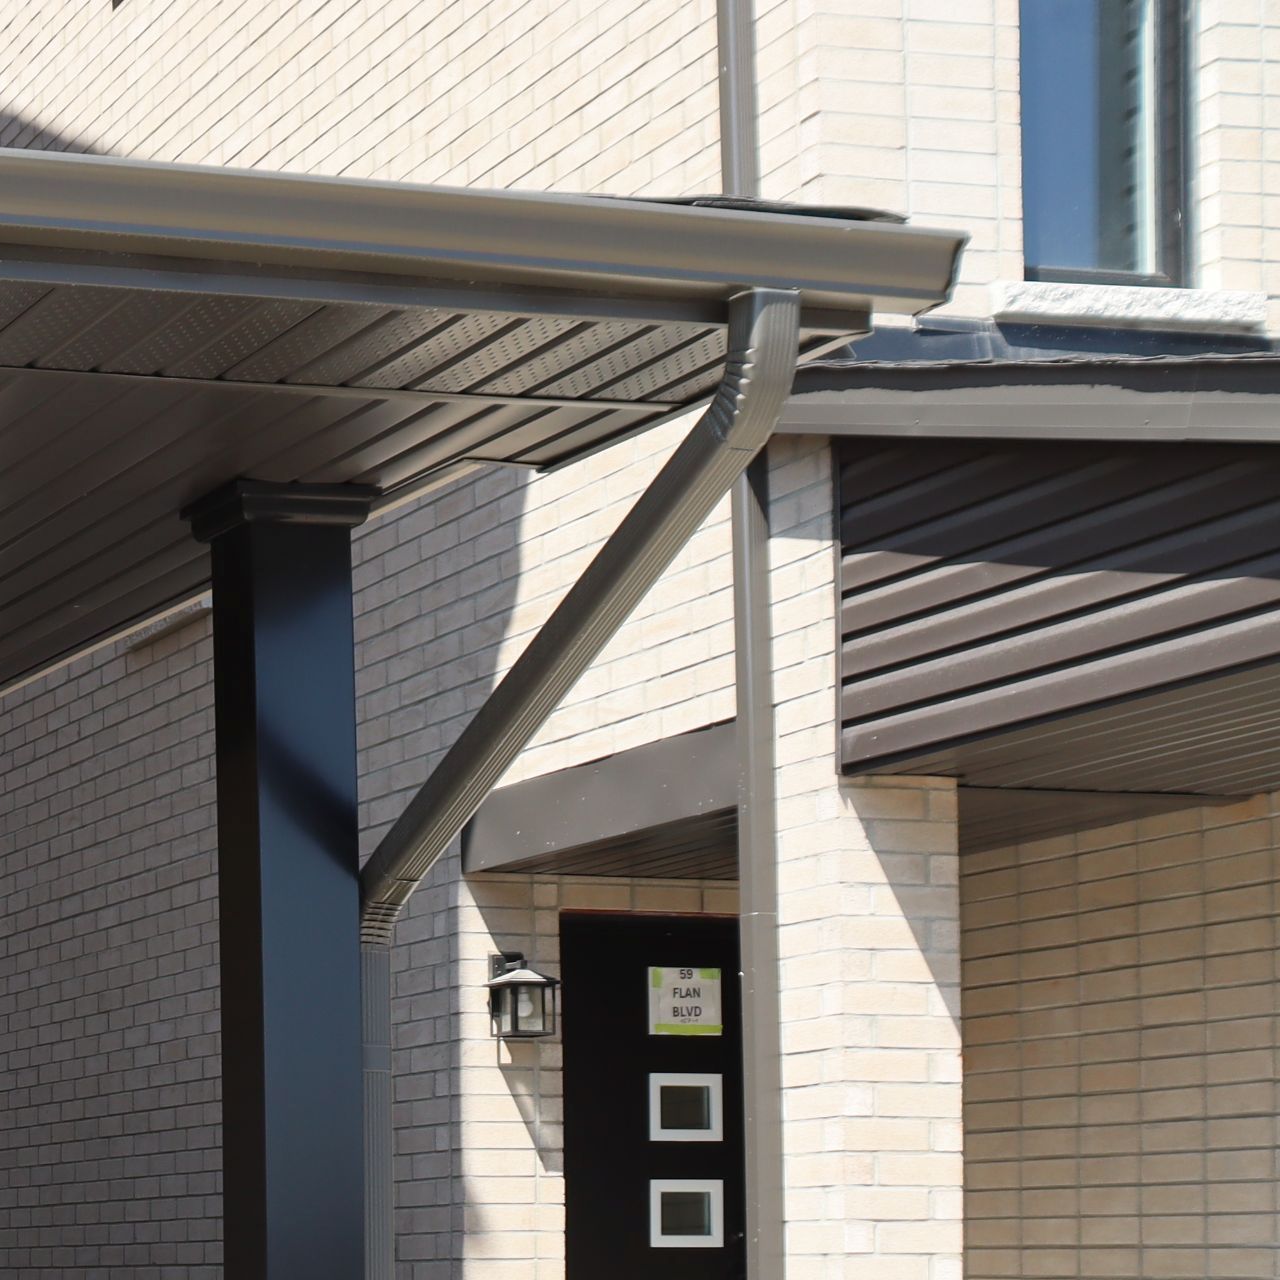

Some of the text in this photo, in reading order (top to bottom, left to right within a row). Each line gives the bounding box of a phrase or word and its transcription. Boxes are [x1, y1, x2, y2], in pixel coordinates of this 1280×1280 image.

[680, 969, 693, 980] 59
[672, 987, 701, 998] FLAN
[672, 1006, 702, 1017] BLVD
